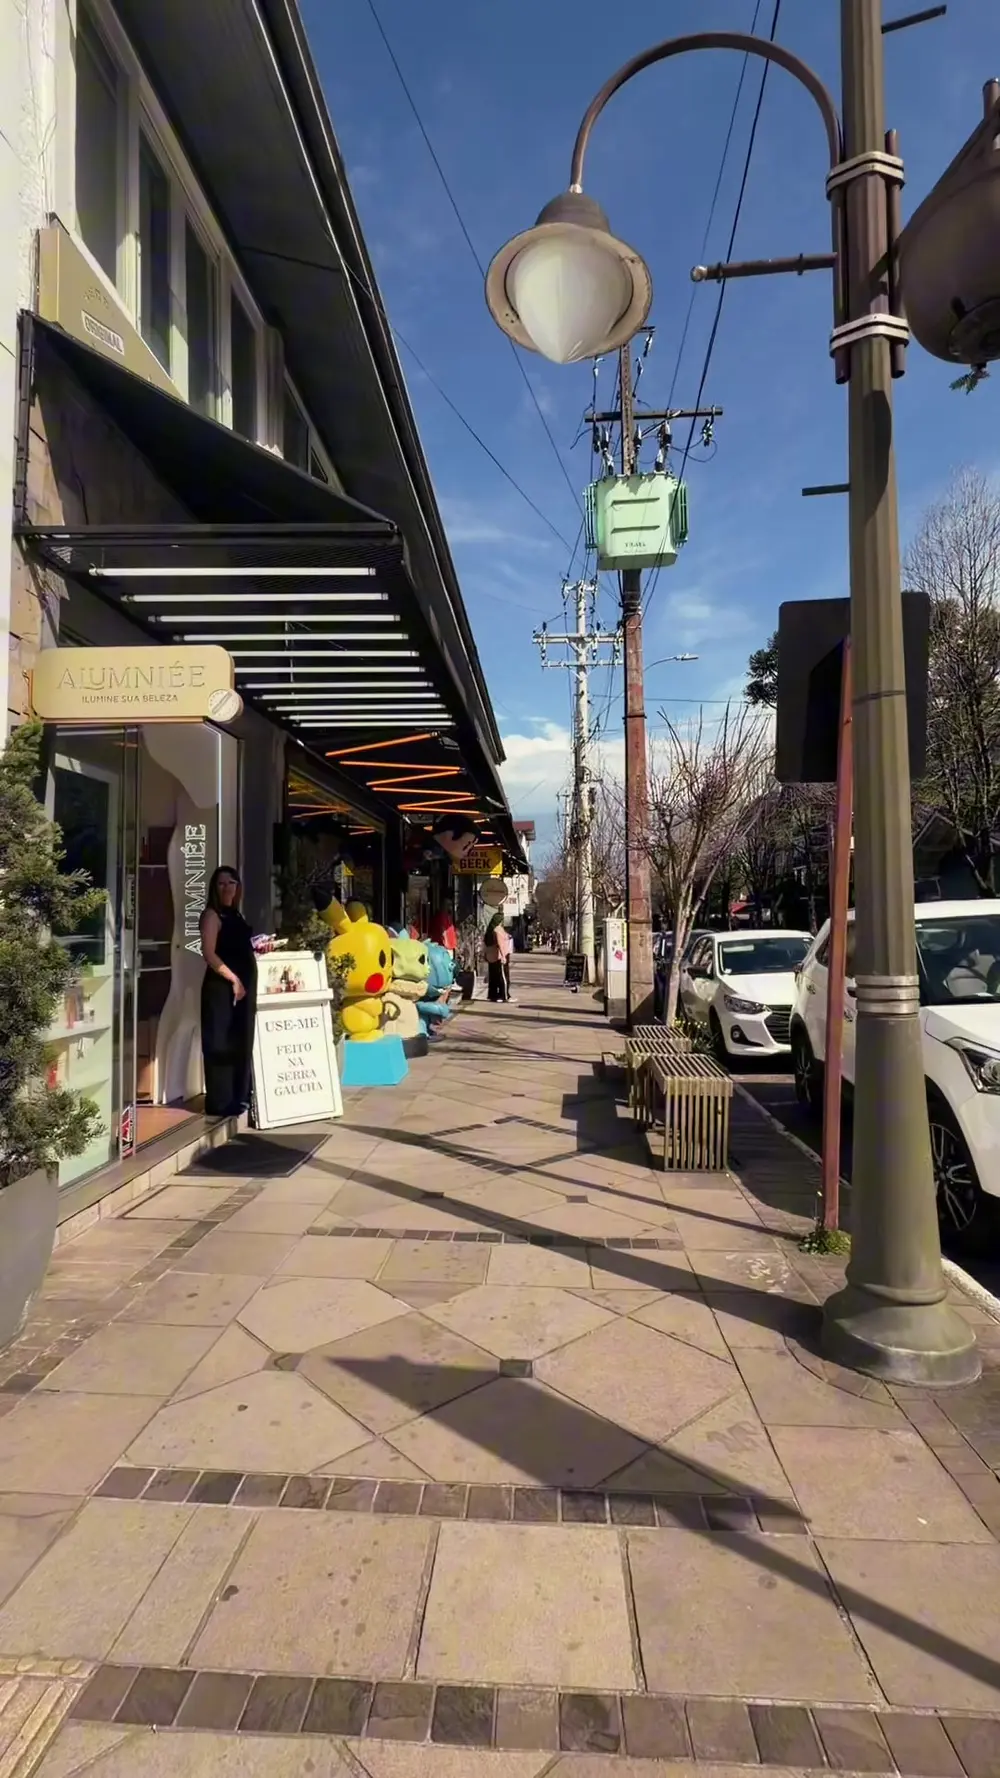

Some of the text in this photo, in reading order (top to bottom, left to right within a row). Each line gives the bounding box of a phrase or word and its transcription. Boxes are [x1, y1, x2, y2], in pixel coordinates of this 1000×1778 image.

[57, 661, 207, 692] ALUMNIÉE
[82, 694, 178, 704] ILUMINE SUA BELEZA
[459, 858, 492, 869] GEEK
[265, 1017, 319, 1032] USE-ME
[277, 1042, 312, 1056] FEITO
[288, 1057, 305, 1067] NA
[277, 1069, 317, 1083] SERRA
